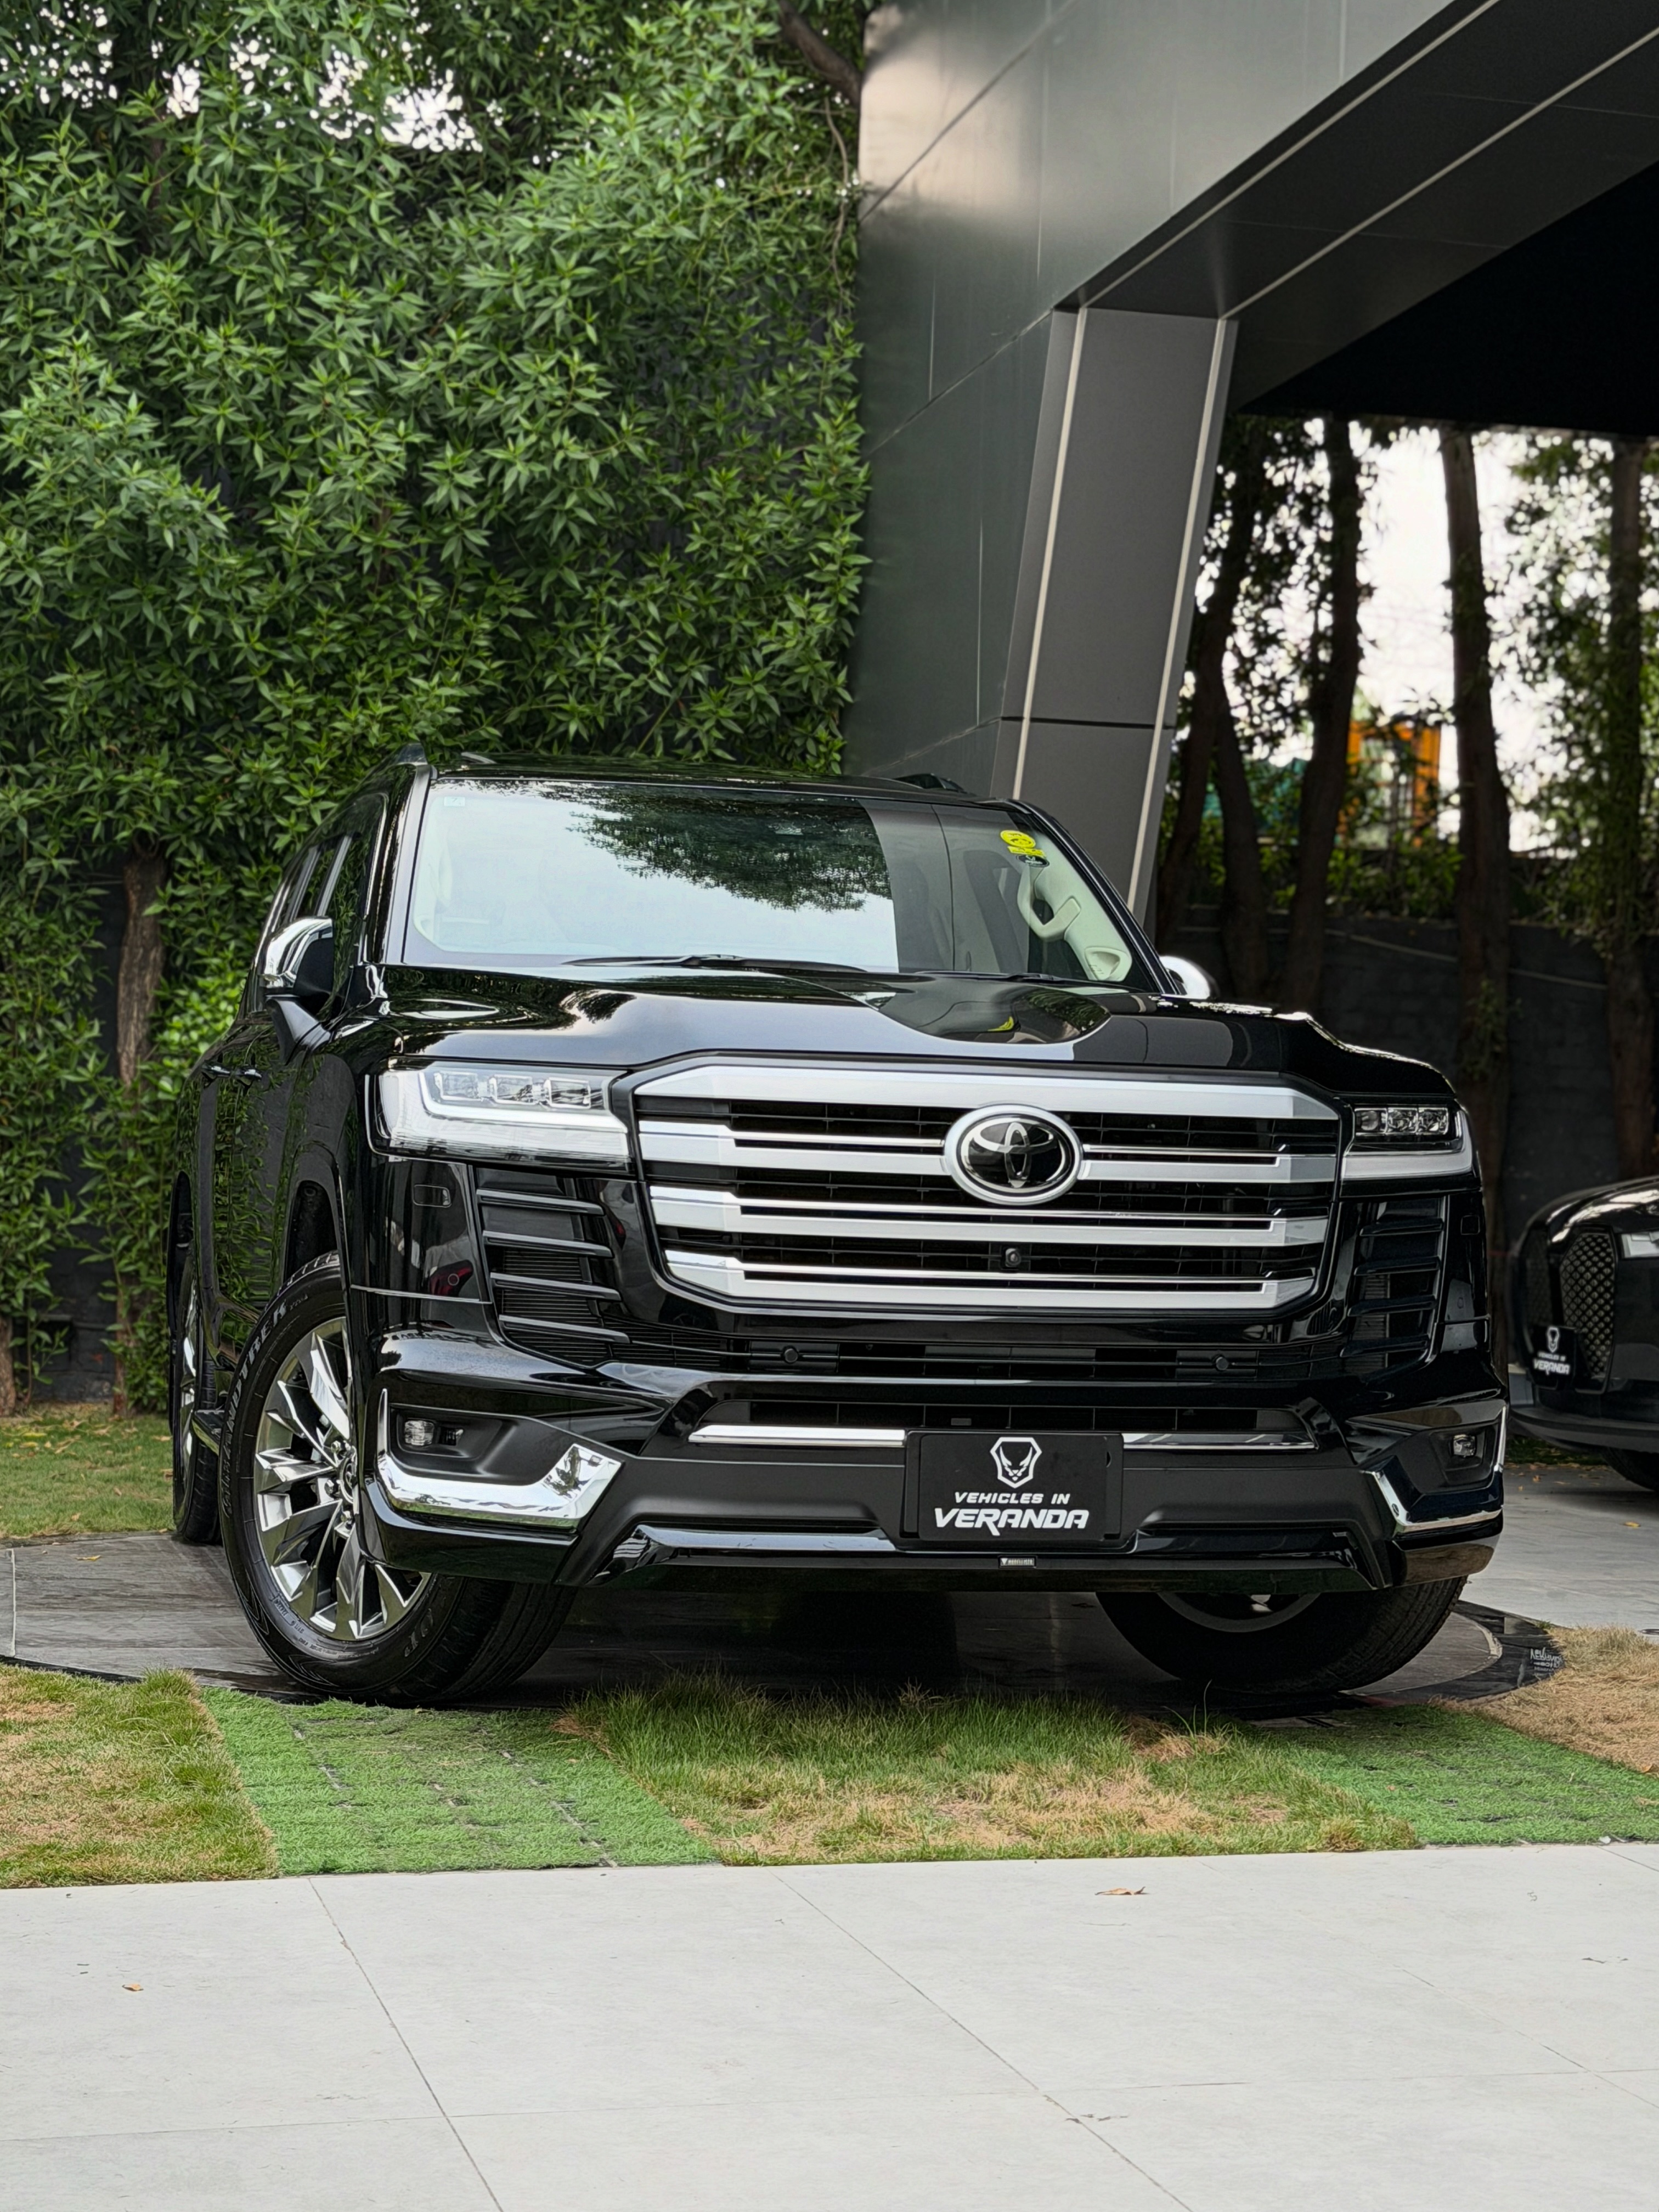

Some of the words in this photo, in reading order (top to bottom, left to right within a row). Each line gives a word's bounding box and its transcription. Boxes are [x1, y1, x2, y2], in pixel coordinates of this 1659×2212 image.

[1533, 1358, 1570, 1375] VERANDA
[955, 1492, 1043, 1504] VEHICLES
[1051, 1493, 1070, 1504] IN
[934, 1508, 1090, 1536] VERANDA
